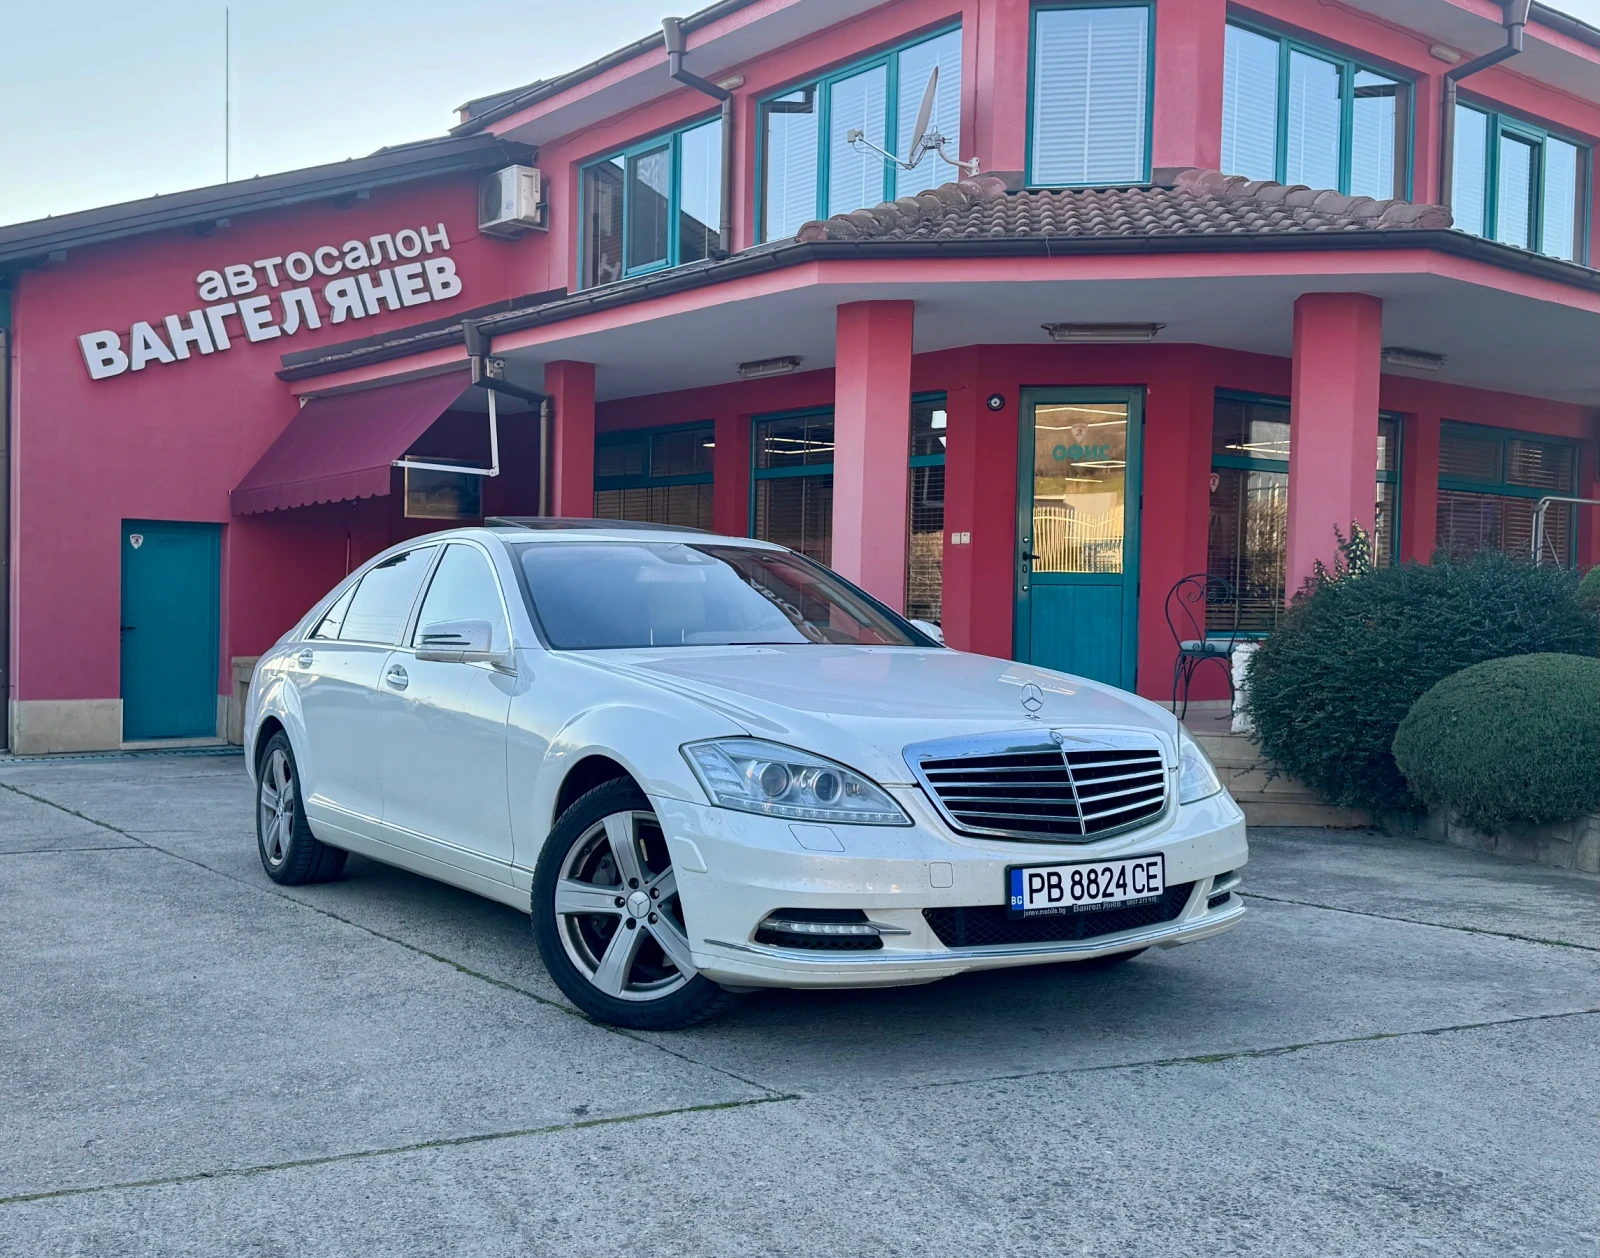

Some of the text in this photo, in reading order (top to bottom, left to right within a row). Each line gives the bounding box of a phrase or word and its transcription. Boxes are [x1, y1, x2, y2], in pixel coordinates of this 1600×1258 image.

[196, 223, 451, 302] автосалон
[78, 256, 463, 380] ВАНГЕЛ ЯНЕВ
[1052, 444, 1110, 462] ОФИС
[1011, 896, 1023, 906] BG
[1028, 862, 1160, 904] PB 8824 CE
